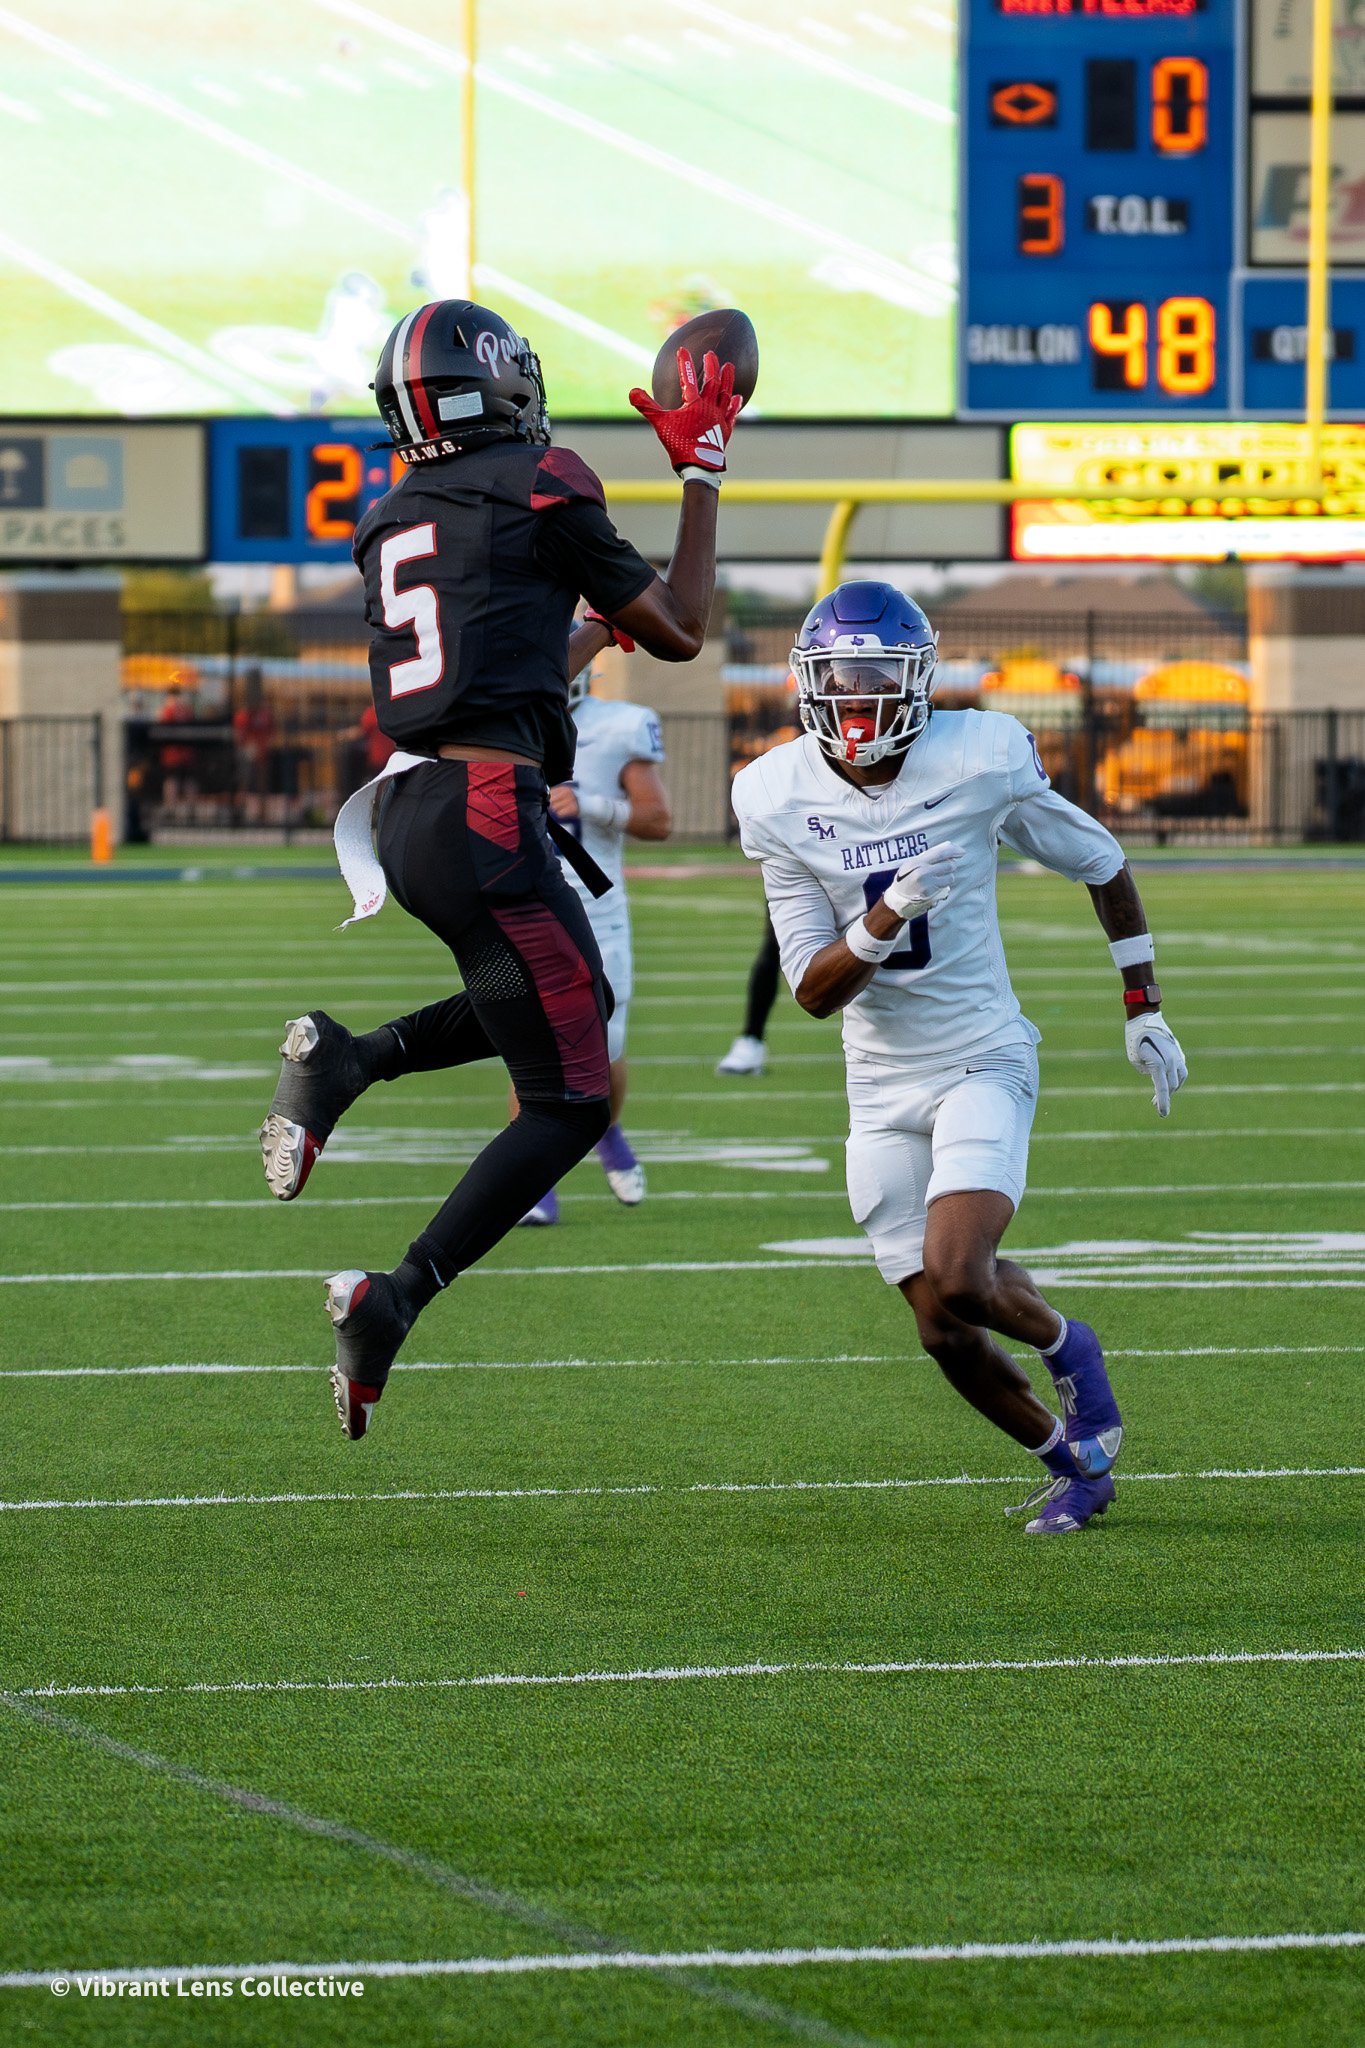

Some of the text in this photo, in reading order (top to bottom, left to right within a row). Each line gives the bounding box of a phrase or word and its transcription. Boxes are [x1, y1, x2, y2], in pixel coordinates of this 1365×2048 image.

[1152, 57, 1208, 153] 0
[1020, 173, 1064, 255] 3
[1090, 196, 1185, 234] T.O.L.
[968, 297, 1215, 394] BALL ON 48
[380, 521, 445, 701] 5
[841, 833, 929, 871] RATTLERS
